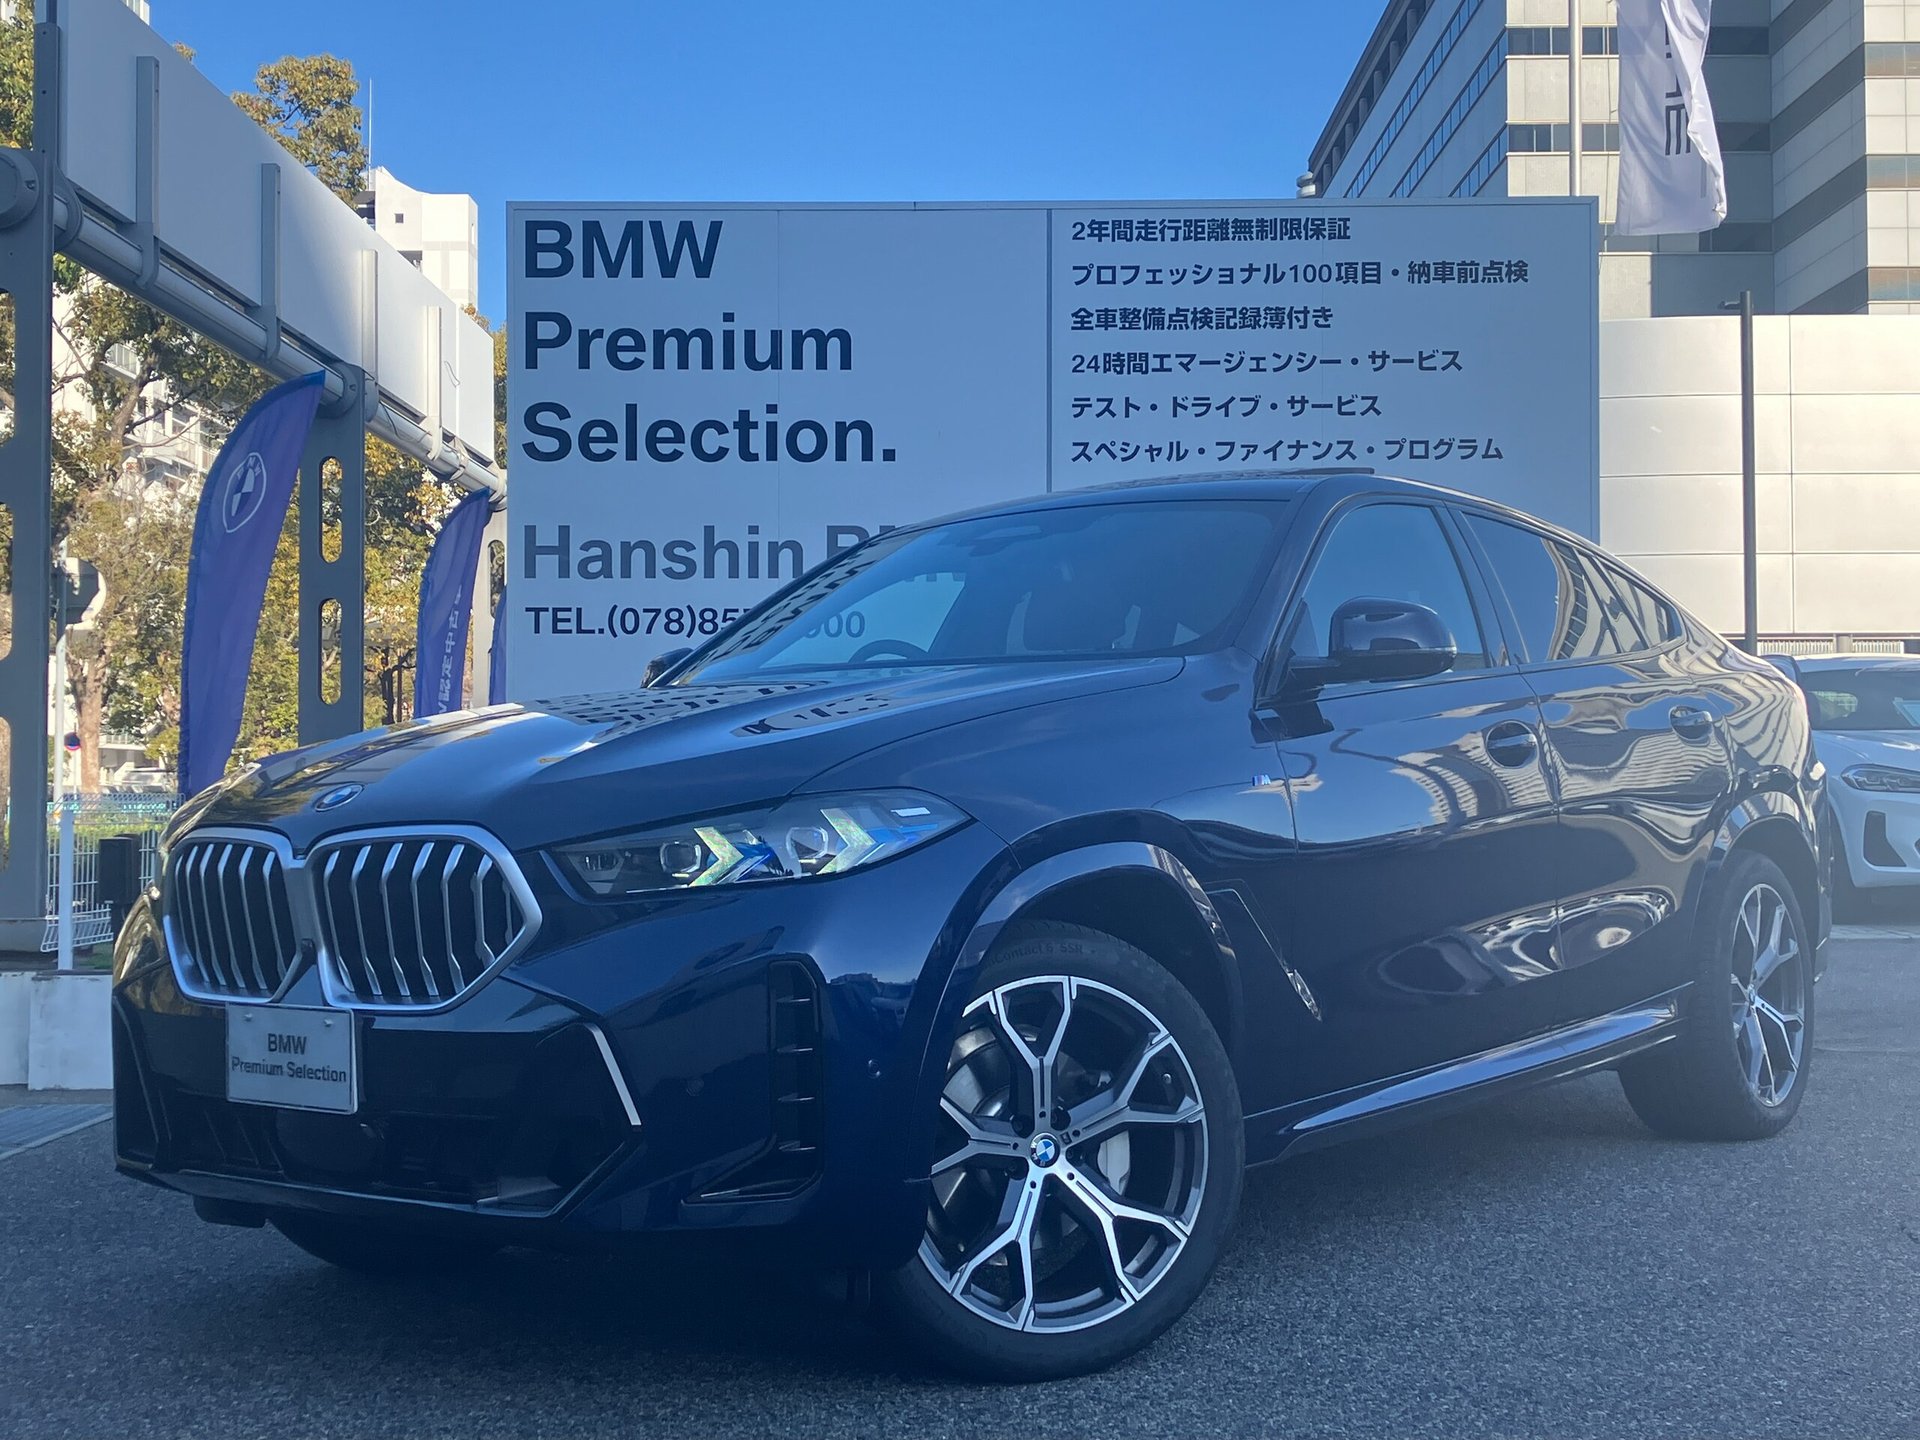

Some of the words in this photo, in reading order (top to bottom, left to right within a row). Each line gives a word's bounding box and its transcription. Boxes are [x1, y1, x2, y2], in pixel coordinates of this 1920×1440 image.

[1071, 217, 1351, 243] 2年間走行距離無制限保証
[525, 220, 723, 278] BMW
[1072, 260, 1529, 286] プロフェッショナル100項目・納車前点検
[1071, 305, 1334, 331] 全車整備点検記録簿付き
[525, 312, 852, 371] Premium
[1071, 350, 1463, 376] 24時間エマージェンシー・サービス
[1071, 395, 1382, 419] テスト・ドライブ・サービス
[521, 402, 896, 462] Selection.
[1071, 437, 1504, 463] スペシャル・ファイナンス・プログラム
[523, 525, 803, 579] Hanshin
[267, 1033, 307, 1055] BMW
[231, 1056, 284, 1077] Premium
[286, 1061, 347, 1083] Selection
